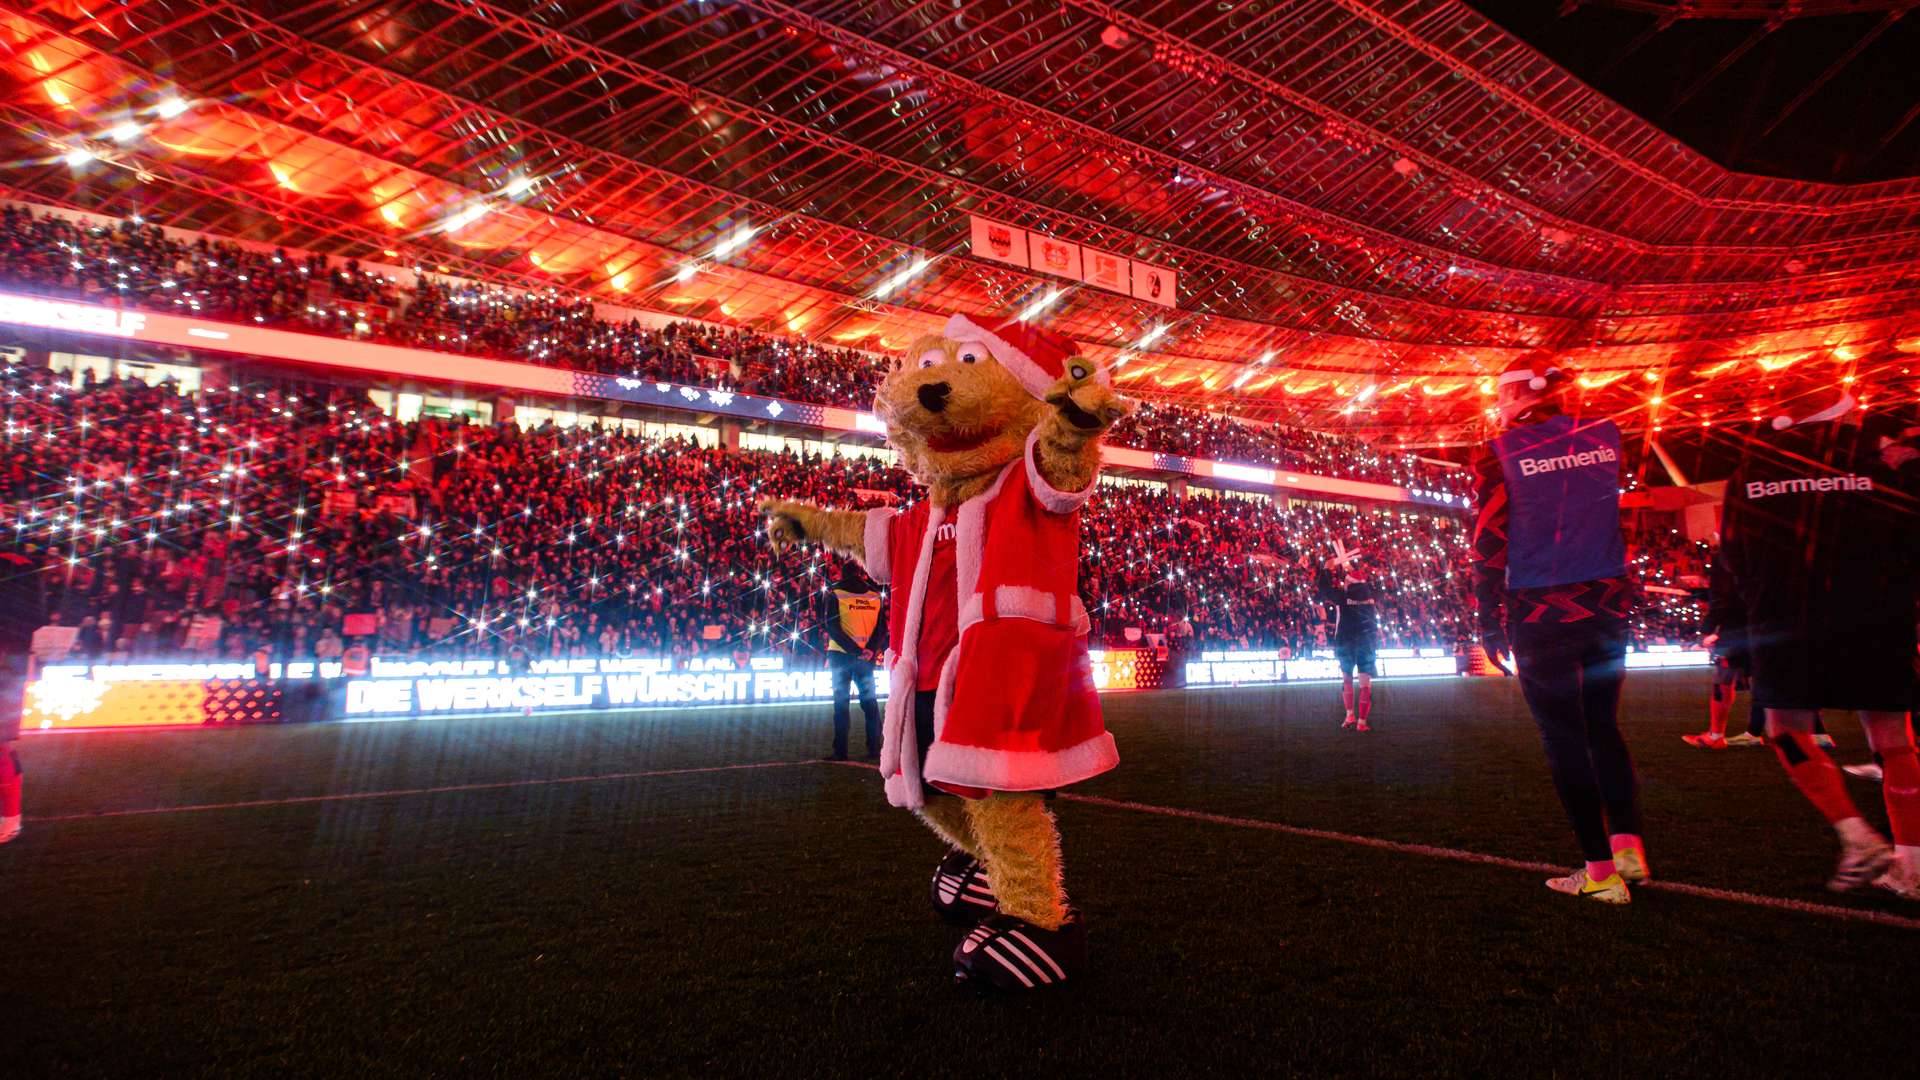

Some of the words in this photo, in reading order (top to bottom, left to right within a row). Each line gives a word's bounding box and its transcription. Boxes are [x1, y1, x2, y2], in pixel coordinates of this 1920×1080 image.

[1519, 445, 1616, 477] Barmenia
[1746, 473, 1873, 499] Barmenia
[346, 680, 412, 713] DIE
[416, 676, 602, 710] WERKSELF
[607, 668, 751, 704] WÜNSCHT
[755, 671, 834, 698] FROHE
